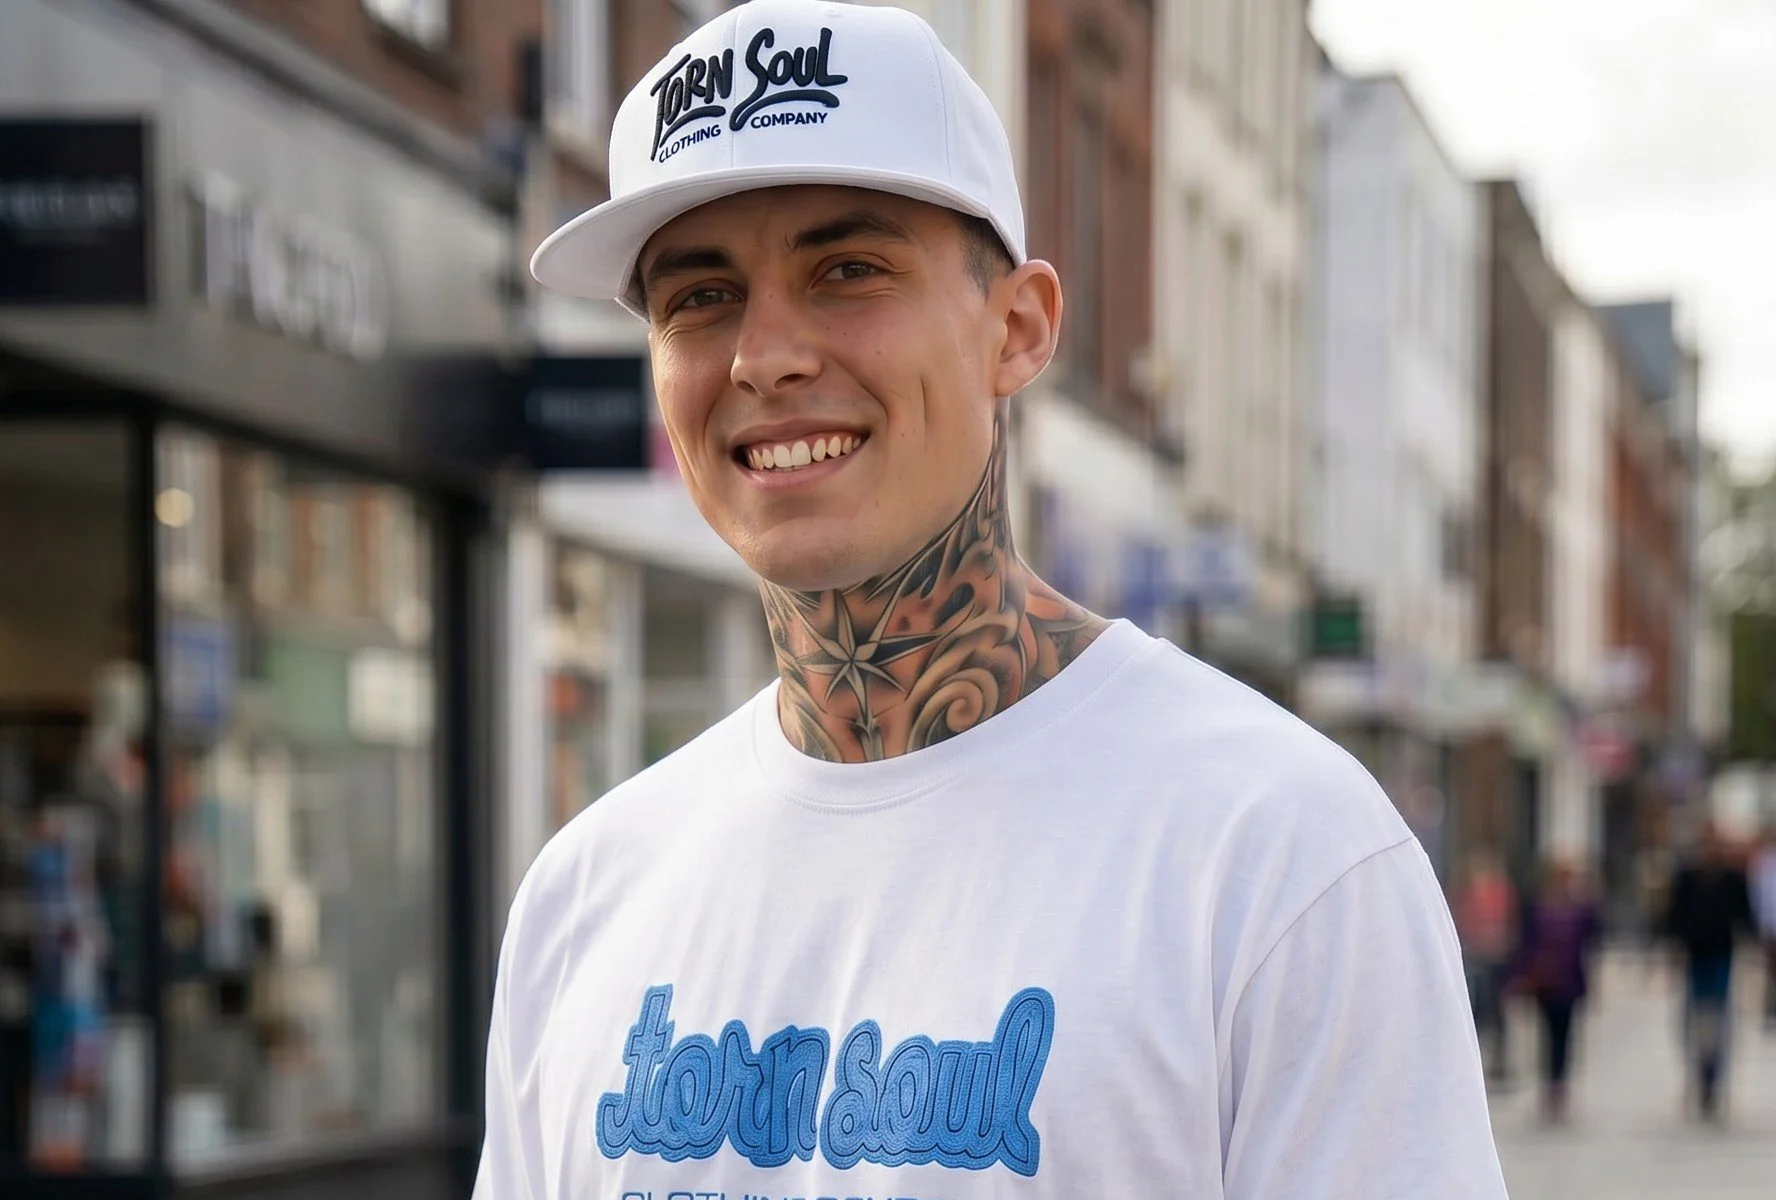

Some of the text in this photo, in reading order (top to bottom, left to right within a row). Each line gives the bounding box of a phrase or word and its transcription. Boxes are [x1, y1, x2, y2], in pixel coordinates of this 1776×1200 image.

[658, 112, 828, 164] CLOTHING COMPANY
[595, 983, 1056, 1178] torn soul
